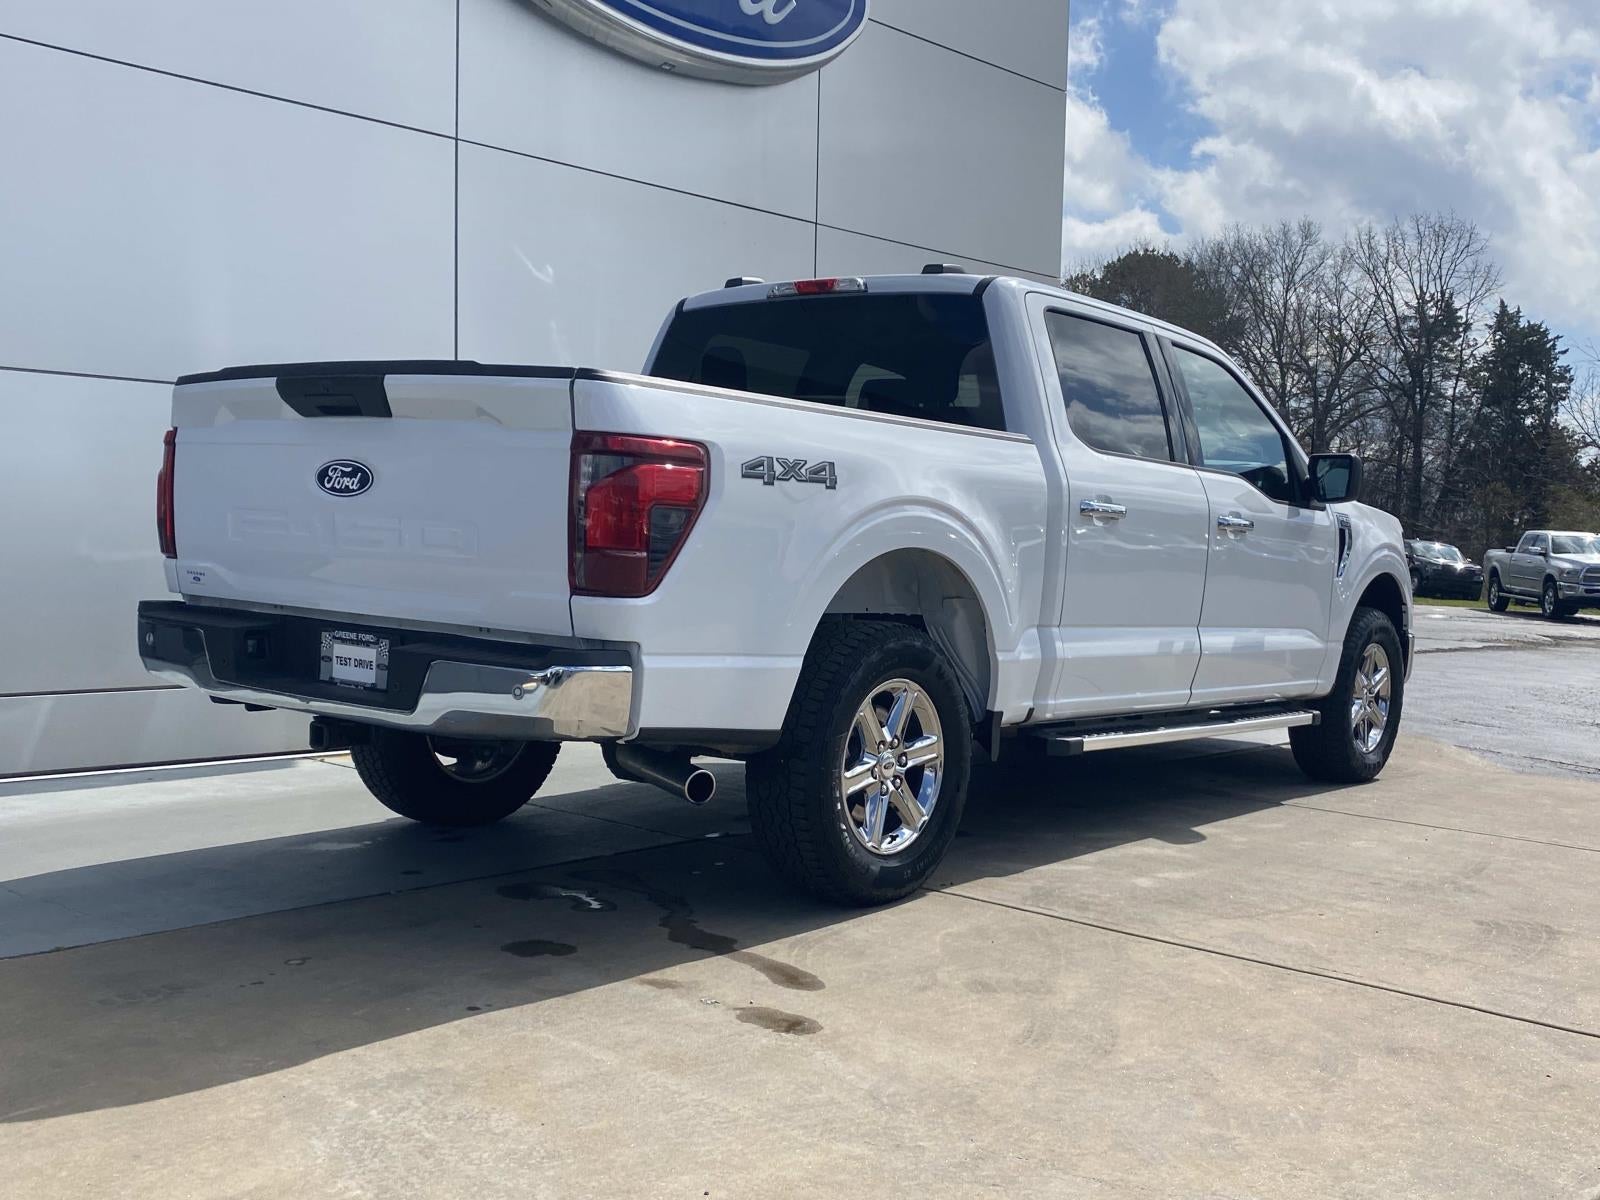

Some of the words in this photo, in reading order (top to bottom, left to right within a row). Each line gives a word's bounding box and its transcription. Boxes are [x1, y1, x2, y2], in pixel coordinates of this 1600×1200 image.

[324, 465, 362, 490] Ford
[334, 630, 358, 640] GREENE
[358, 632, 377, 642] FORD
[334, 655, 352, 667] TEST
[353, 658, 374, 671] DRIVE
